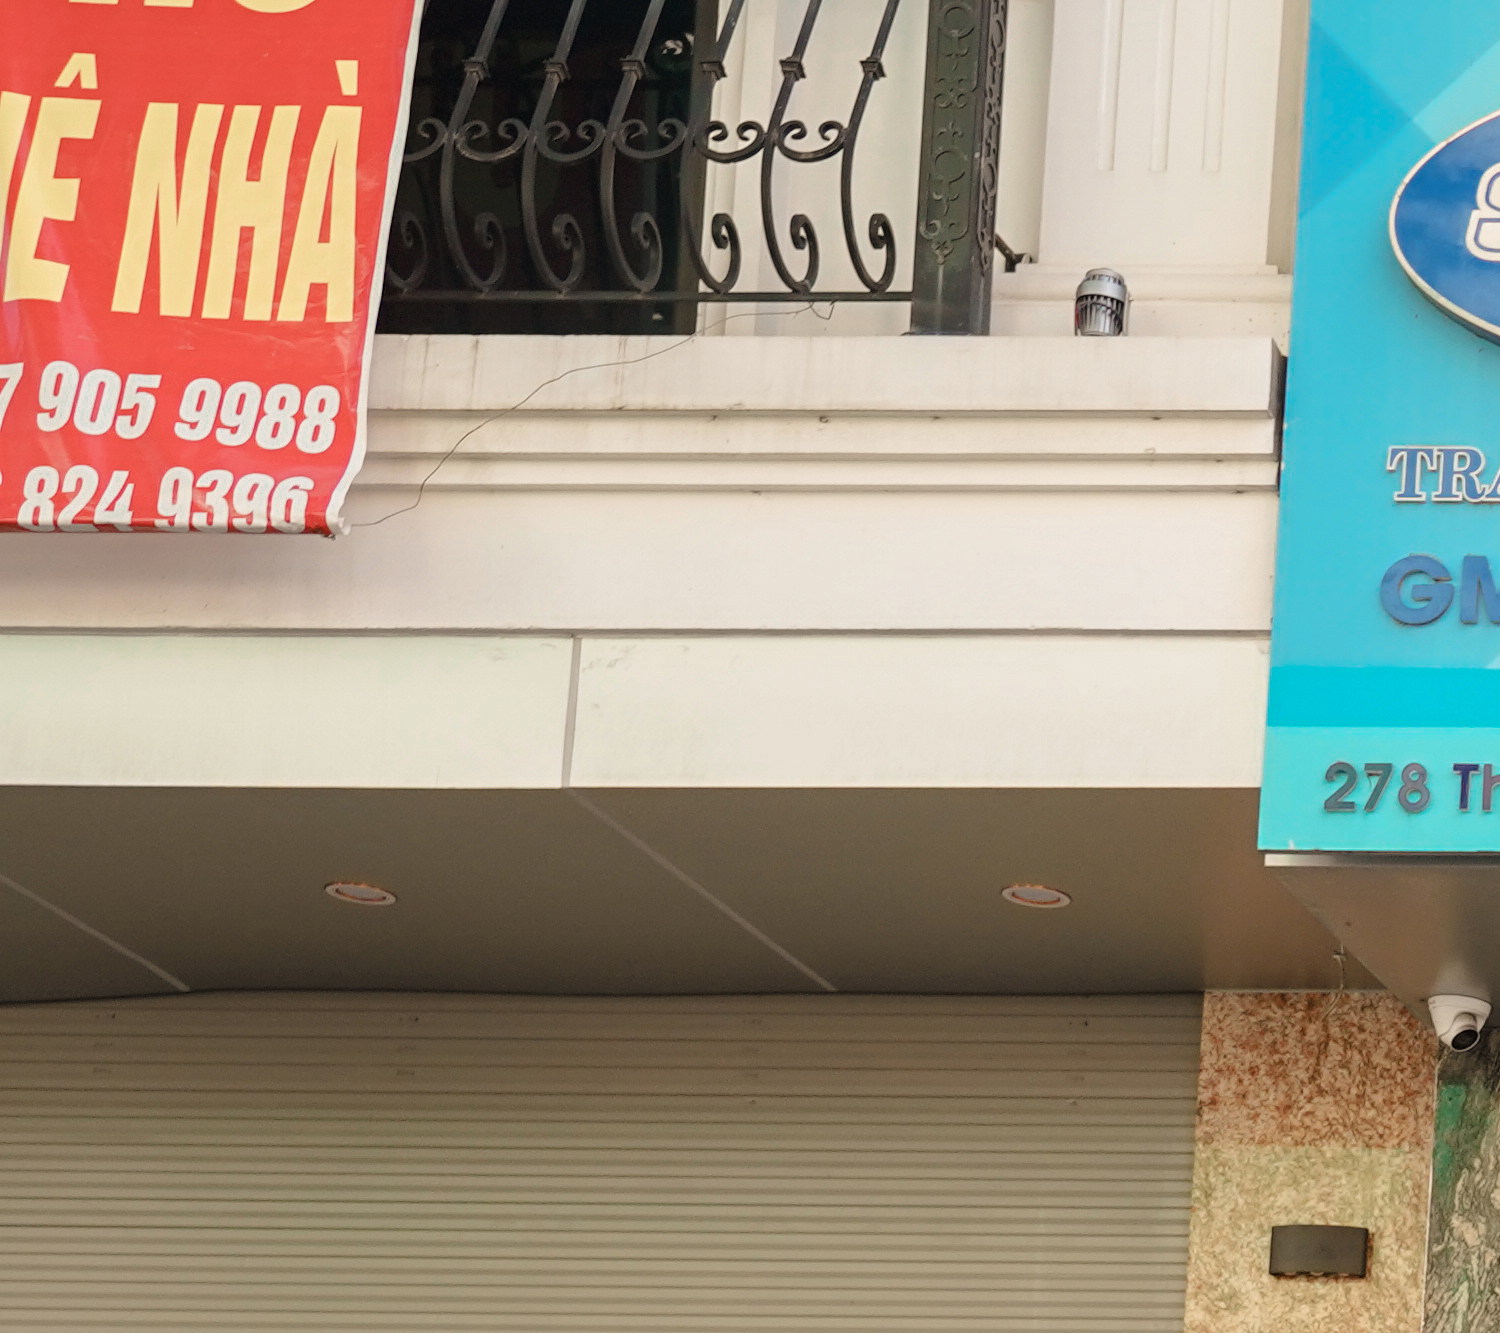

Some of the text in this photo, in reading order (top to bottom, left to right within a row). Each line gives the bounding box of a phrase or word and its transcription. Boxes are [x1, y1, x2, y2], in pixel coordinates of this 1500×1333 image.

[111, 60, 363, 324] NHÀ
[37, 361, 162, 440] 905
[174, 378, 341, 454] 9988
[17, 465, 315, 535] 824 9396
[1324, 762, 1431, 815] 278
